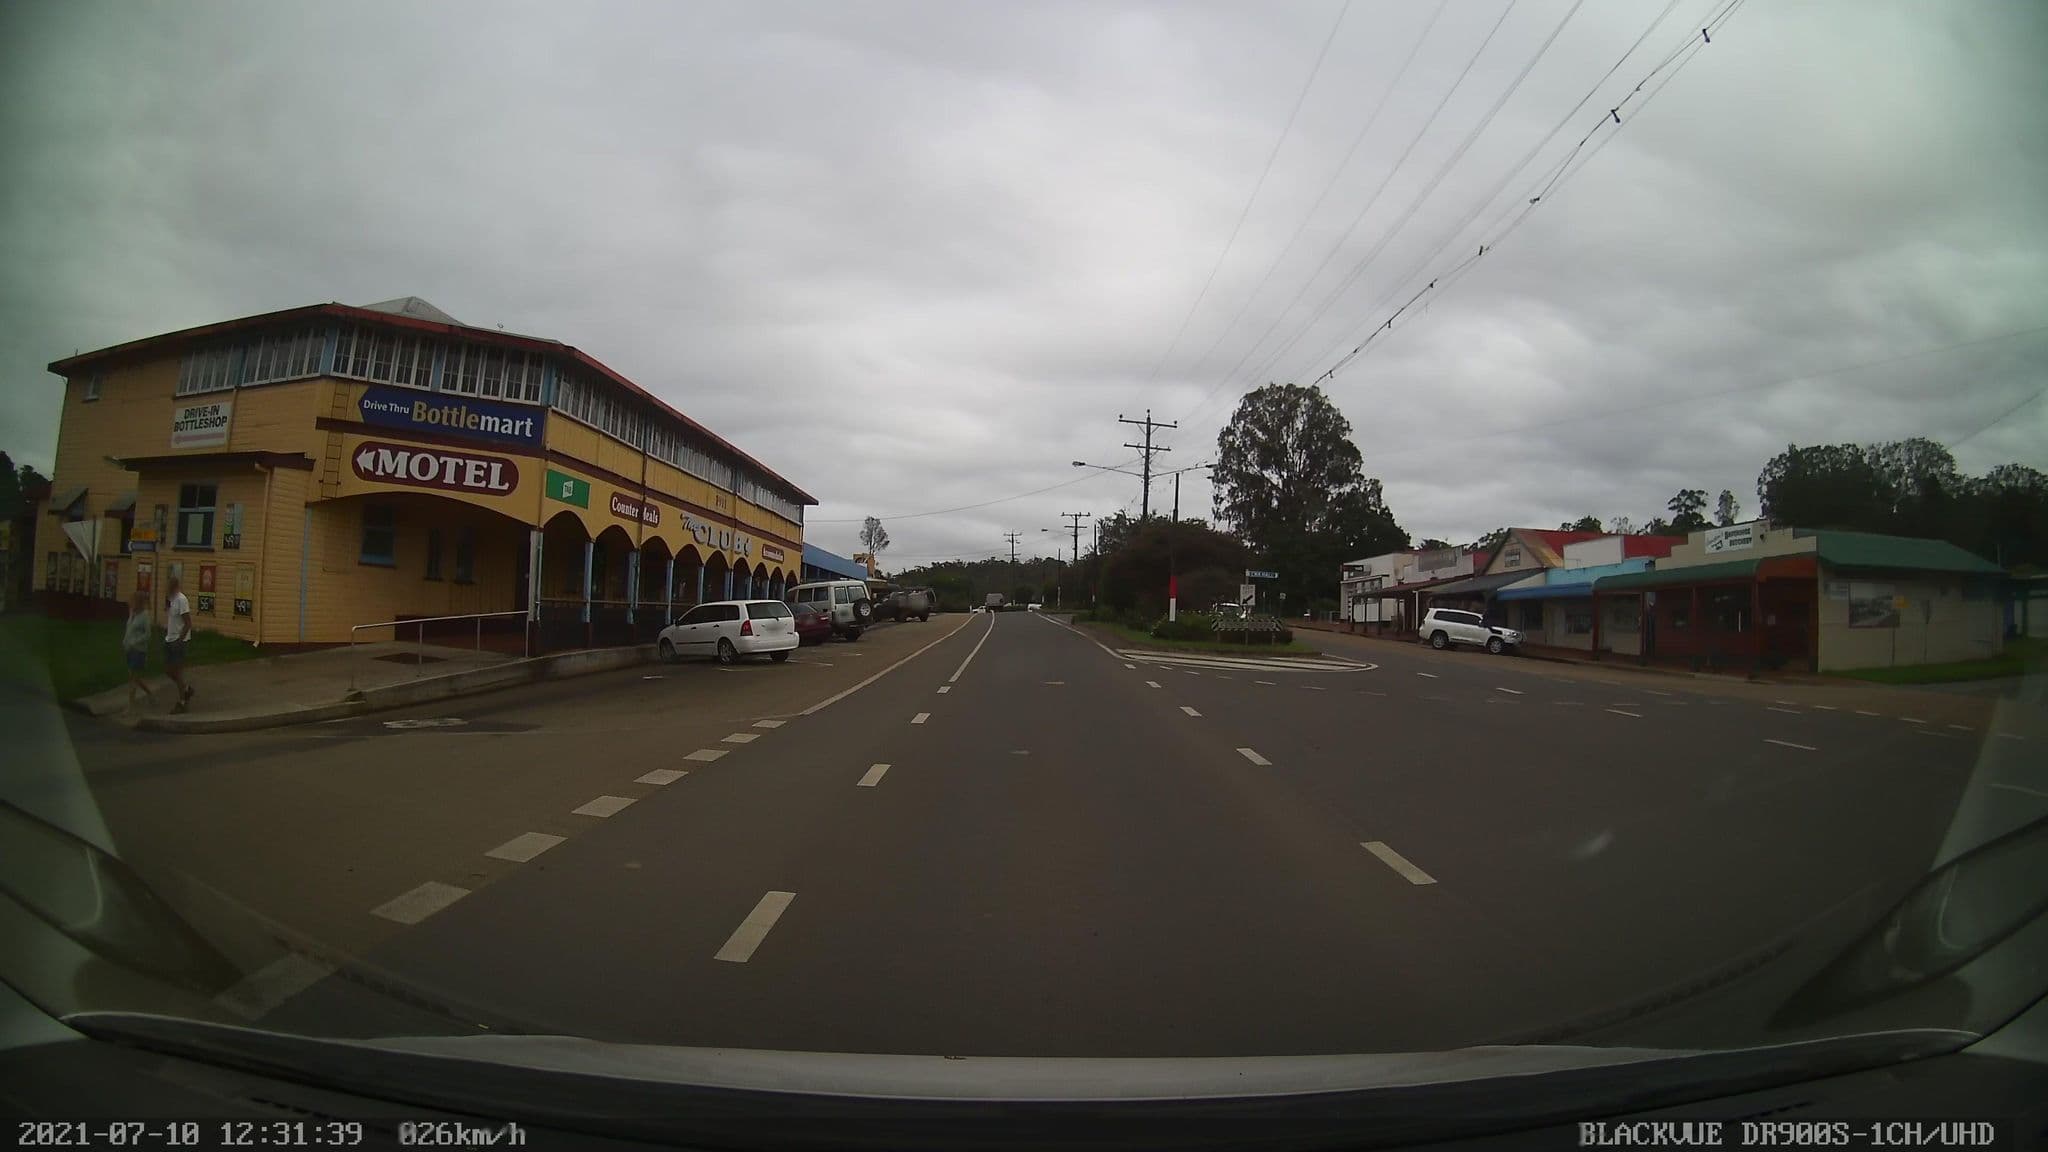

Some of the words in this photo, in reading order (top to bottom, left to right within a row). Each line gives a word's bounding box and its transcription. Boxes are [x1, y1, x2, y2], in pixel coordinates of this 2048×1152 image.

[184, 405, 220, 419] DRIVE-IN
[363, 399, 388, 412] Drive
[389, 402, 410, 415] Thru
[412, 400, 534, 438] Bottlemart
[173, 416, 228, 433] BOTTLESHOP
[375, 448, 510, 491] MOTEL
[611, 497, 639, 519] Counter
